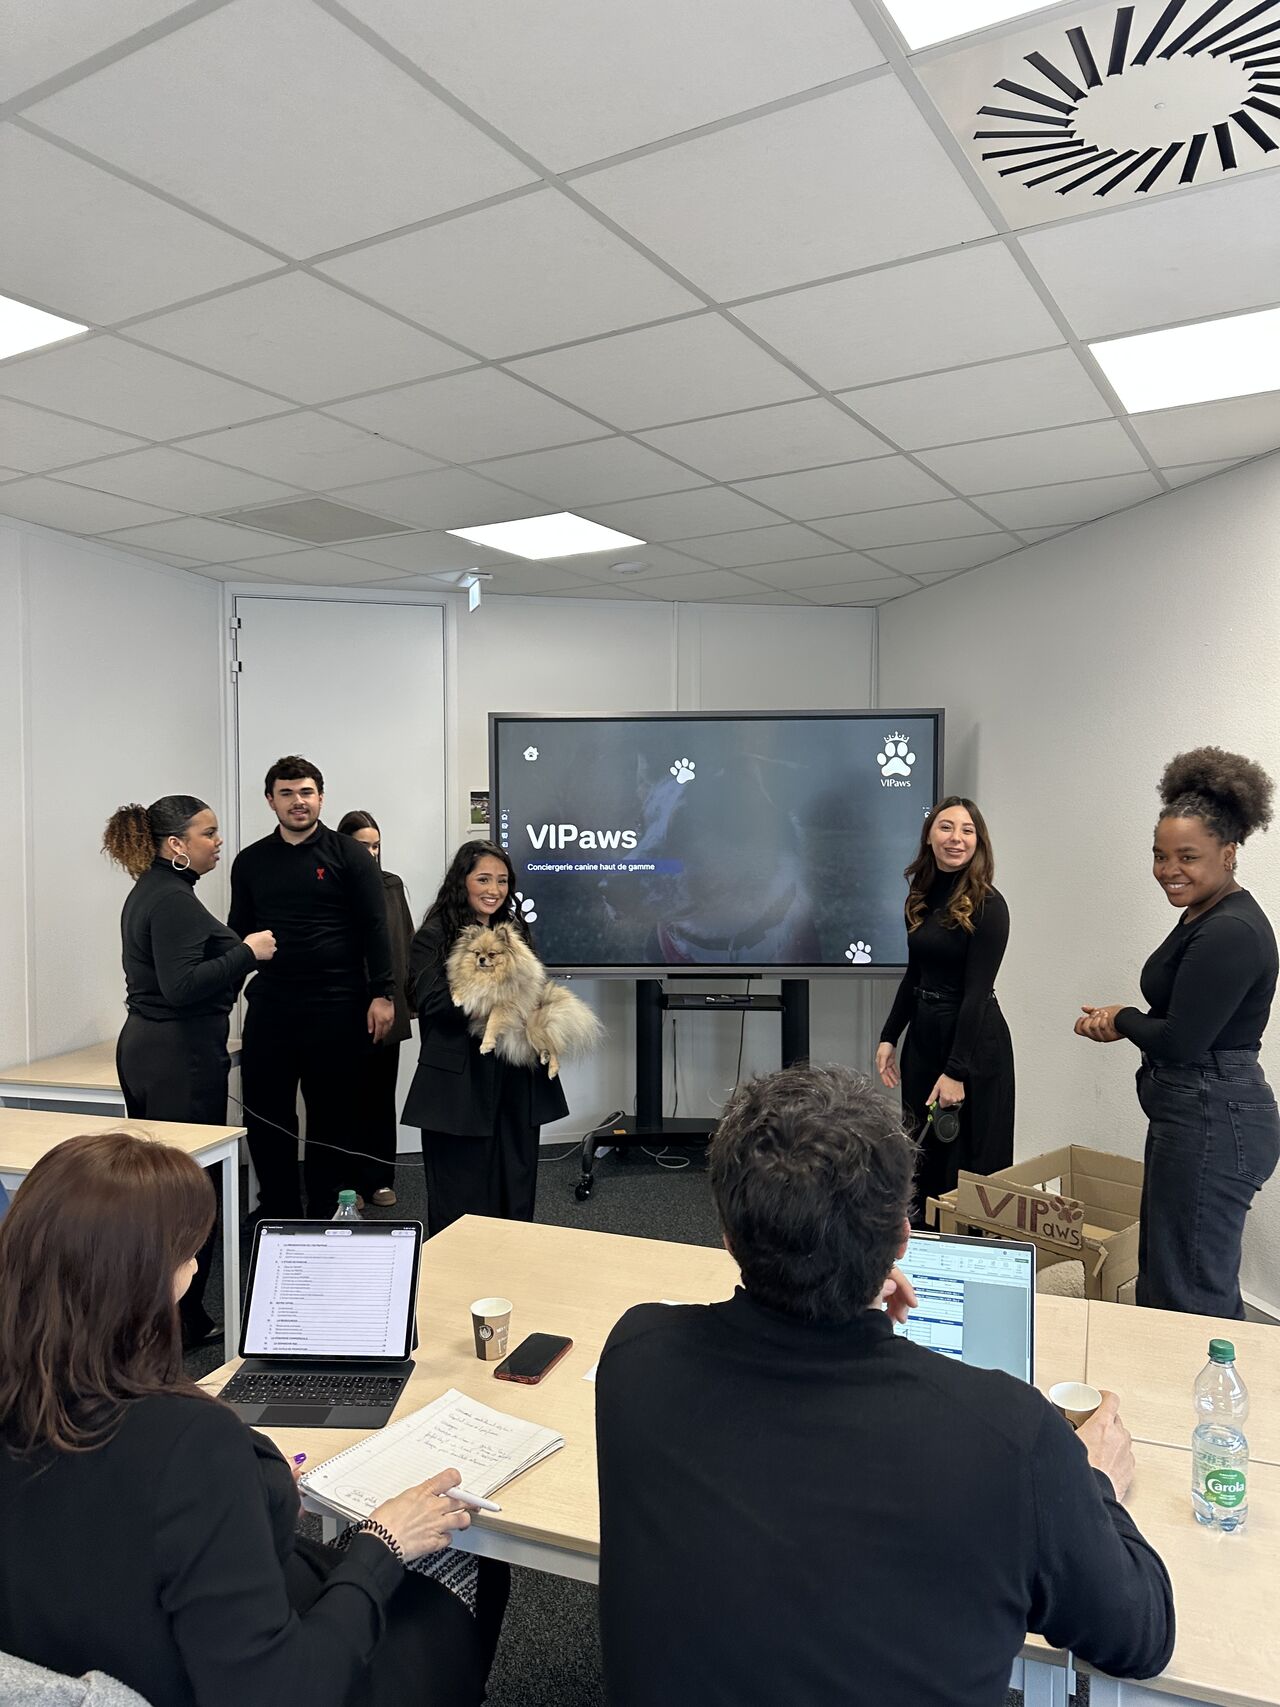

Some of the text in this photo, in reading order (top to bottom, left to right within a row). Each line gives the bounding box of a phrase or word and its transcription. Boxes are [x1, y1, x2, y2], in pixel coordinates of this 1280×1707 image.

[880, 778, 912, 788] VIPaws
[525, 823, 638, 850] VIPaws
[527, 863, 656, 873] Conciergerie canine haut de gamme
[1207, 1478, 1245, 1494] Carola
